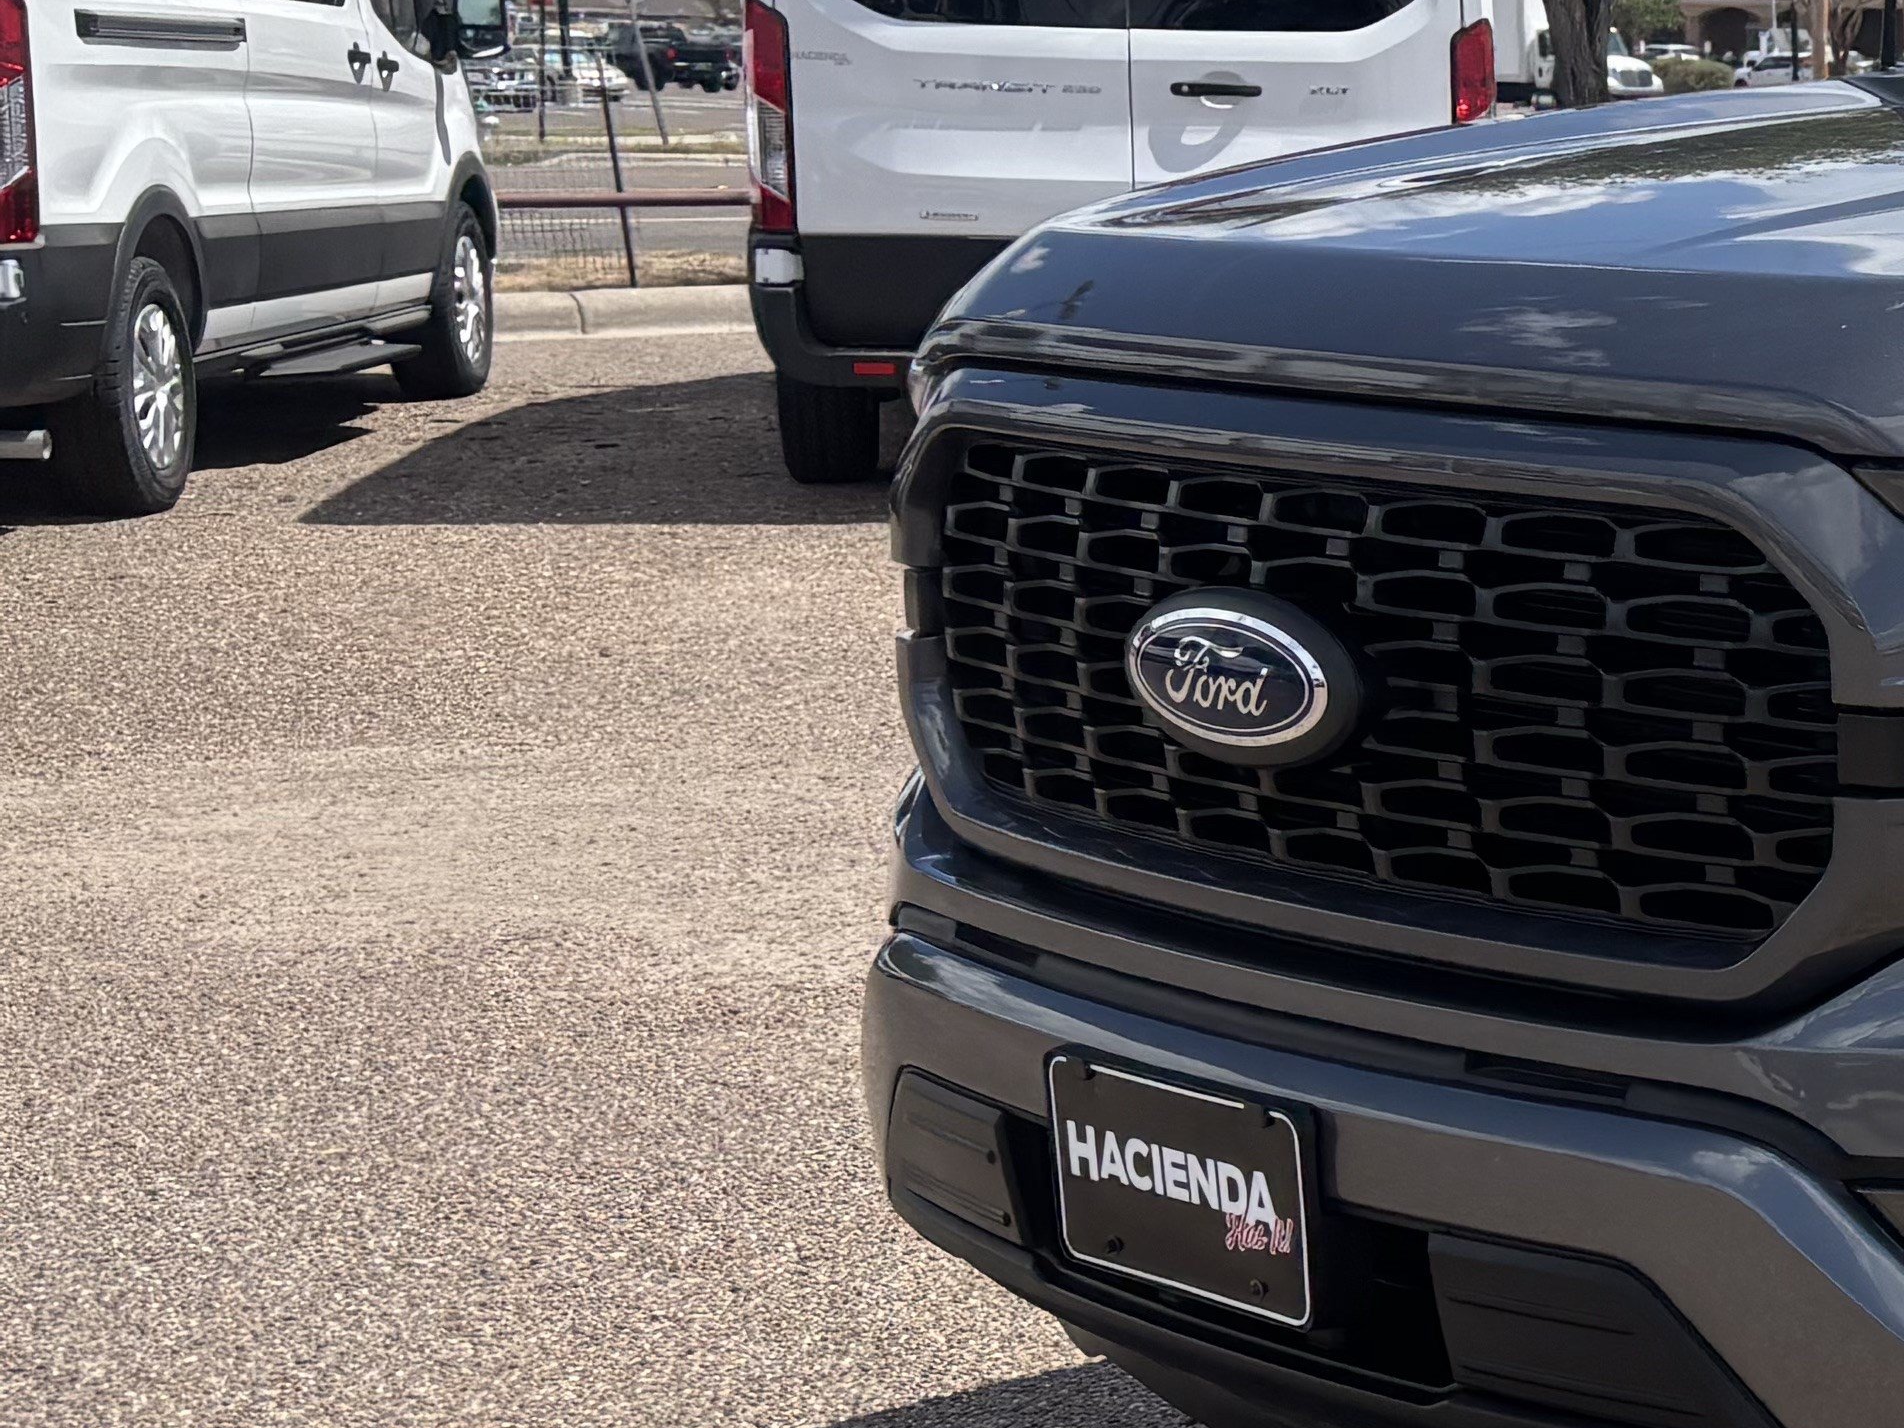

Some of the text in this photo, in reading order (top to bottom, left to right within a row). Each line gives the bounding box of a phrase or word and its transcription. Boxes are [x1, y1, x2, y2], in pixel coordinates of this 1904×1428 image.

[1165, 635, 1268, 716] Ford
[1065, 1119, 1277, 1232] HACIENDA
[1225, 1213, 1268, 1252] Has
